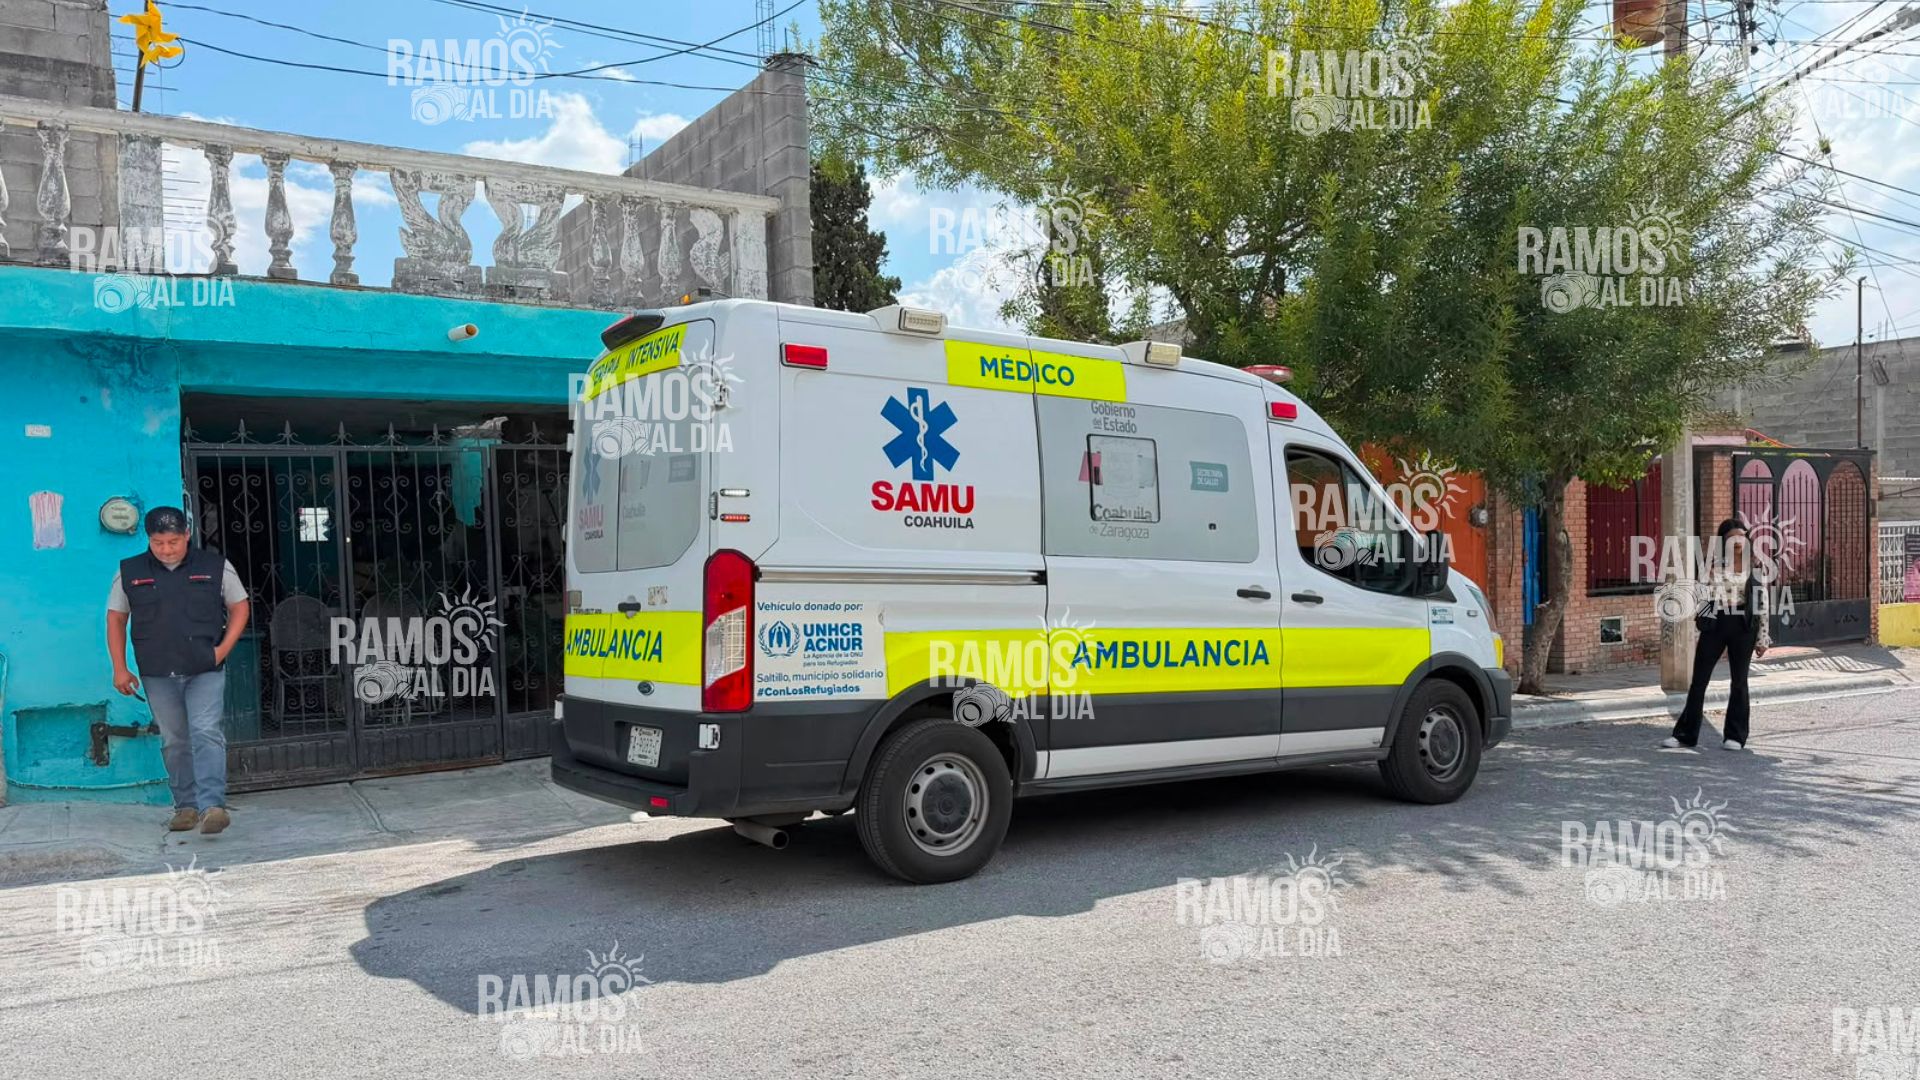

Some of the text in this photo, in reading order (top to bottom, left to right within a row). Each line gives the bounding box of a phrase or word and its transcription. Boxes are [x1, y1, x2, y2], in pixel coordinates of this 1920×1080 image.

[626, 332, 680, 370] INTENSIVA
[980, 354, 1075, 386] MÉDICO
[1091, 400, 1135, 418] Gobierno
[1103, 416, 1137, 433] Estado
[870, 480, 975, 514] SAMU
[578, 503, 605, 530] SAMU
[1091, 503, 1152, 521] Coahuila
[903, 515, 975, 529] COAHUILA
[1100, 522, 1149, 541] Zaragoza
[804, 602, 841, 611] donado
[844, 603, 863, 613] por:
[803, 622, 863, 637] UNHCR
[566, 627, 663, 664] AMBULANCIA
[803, 637, 863, 652] ACNUR
[812, 652, 834, 660] Agencia
[1070, 639, 1270, 670] AMBULANCIA
[827, 659, 858, 668] Refugiados
[757, 669, 884, 683] Saltillo, municipio solidario
[757, 684, 861, 697] #ConLosRefugiados
